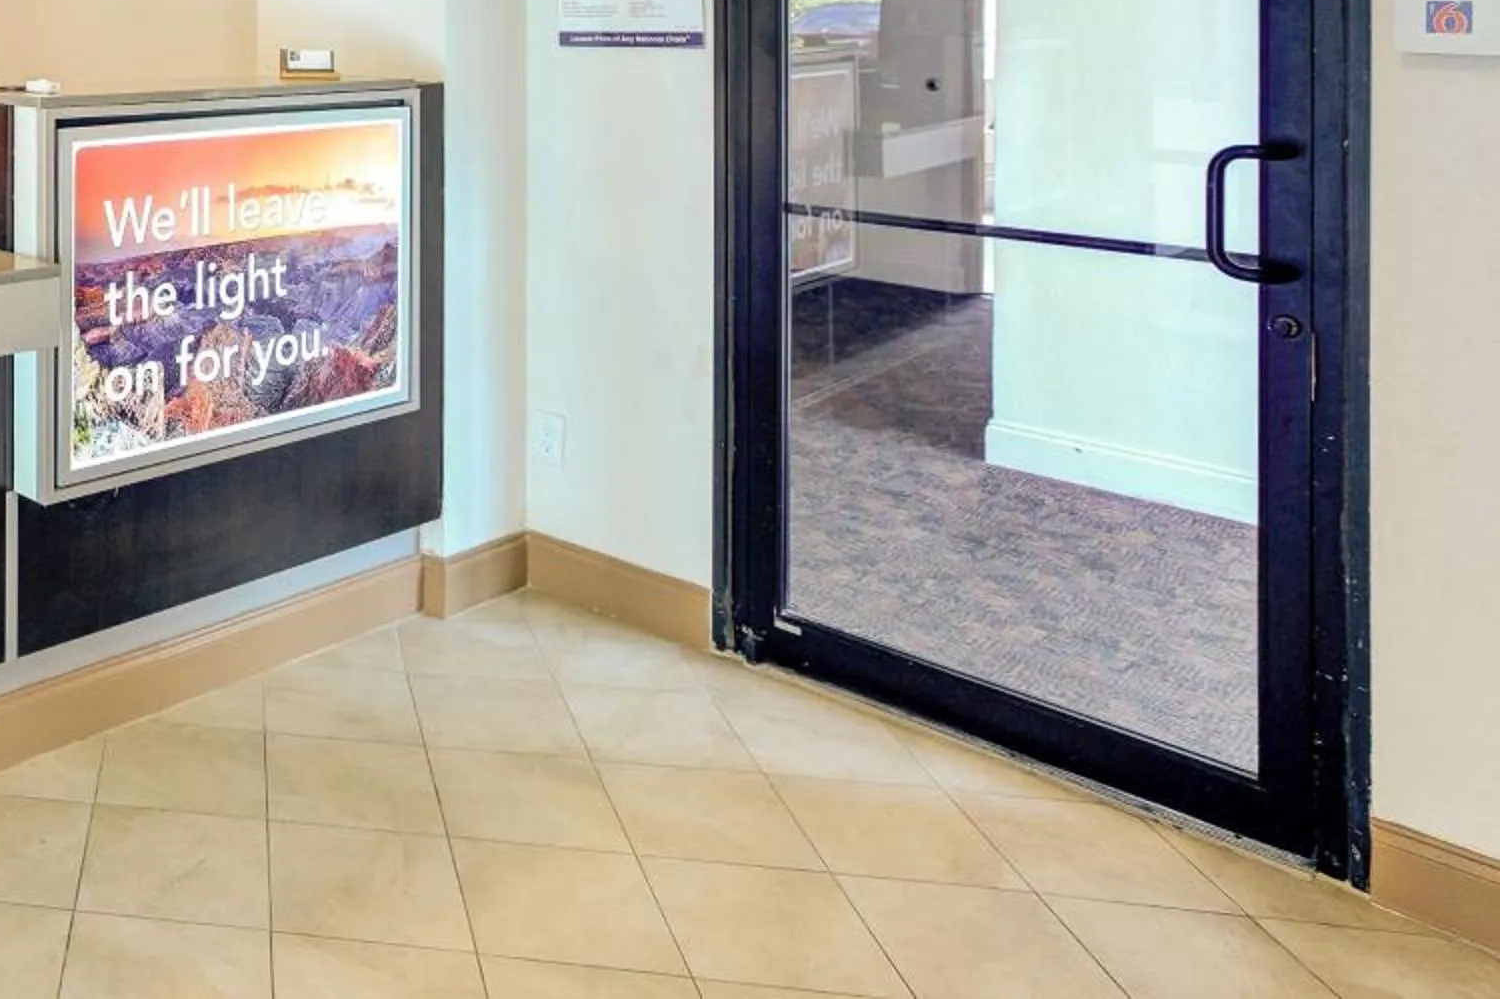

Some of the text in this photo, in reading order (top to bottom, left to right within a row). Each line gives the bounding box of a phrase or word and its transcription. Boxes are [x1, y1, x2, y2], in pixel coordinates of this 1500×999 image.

[103, 183, 328, 248] We'll leave
[104, 252, 287, 326] the light
[104, 329, 329, 402] on for you.
